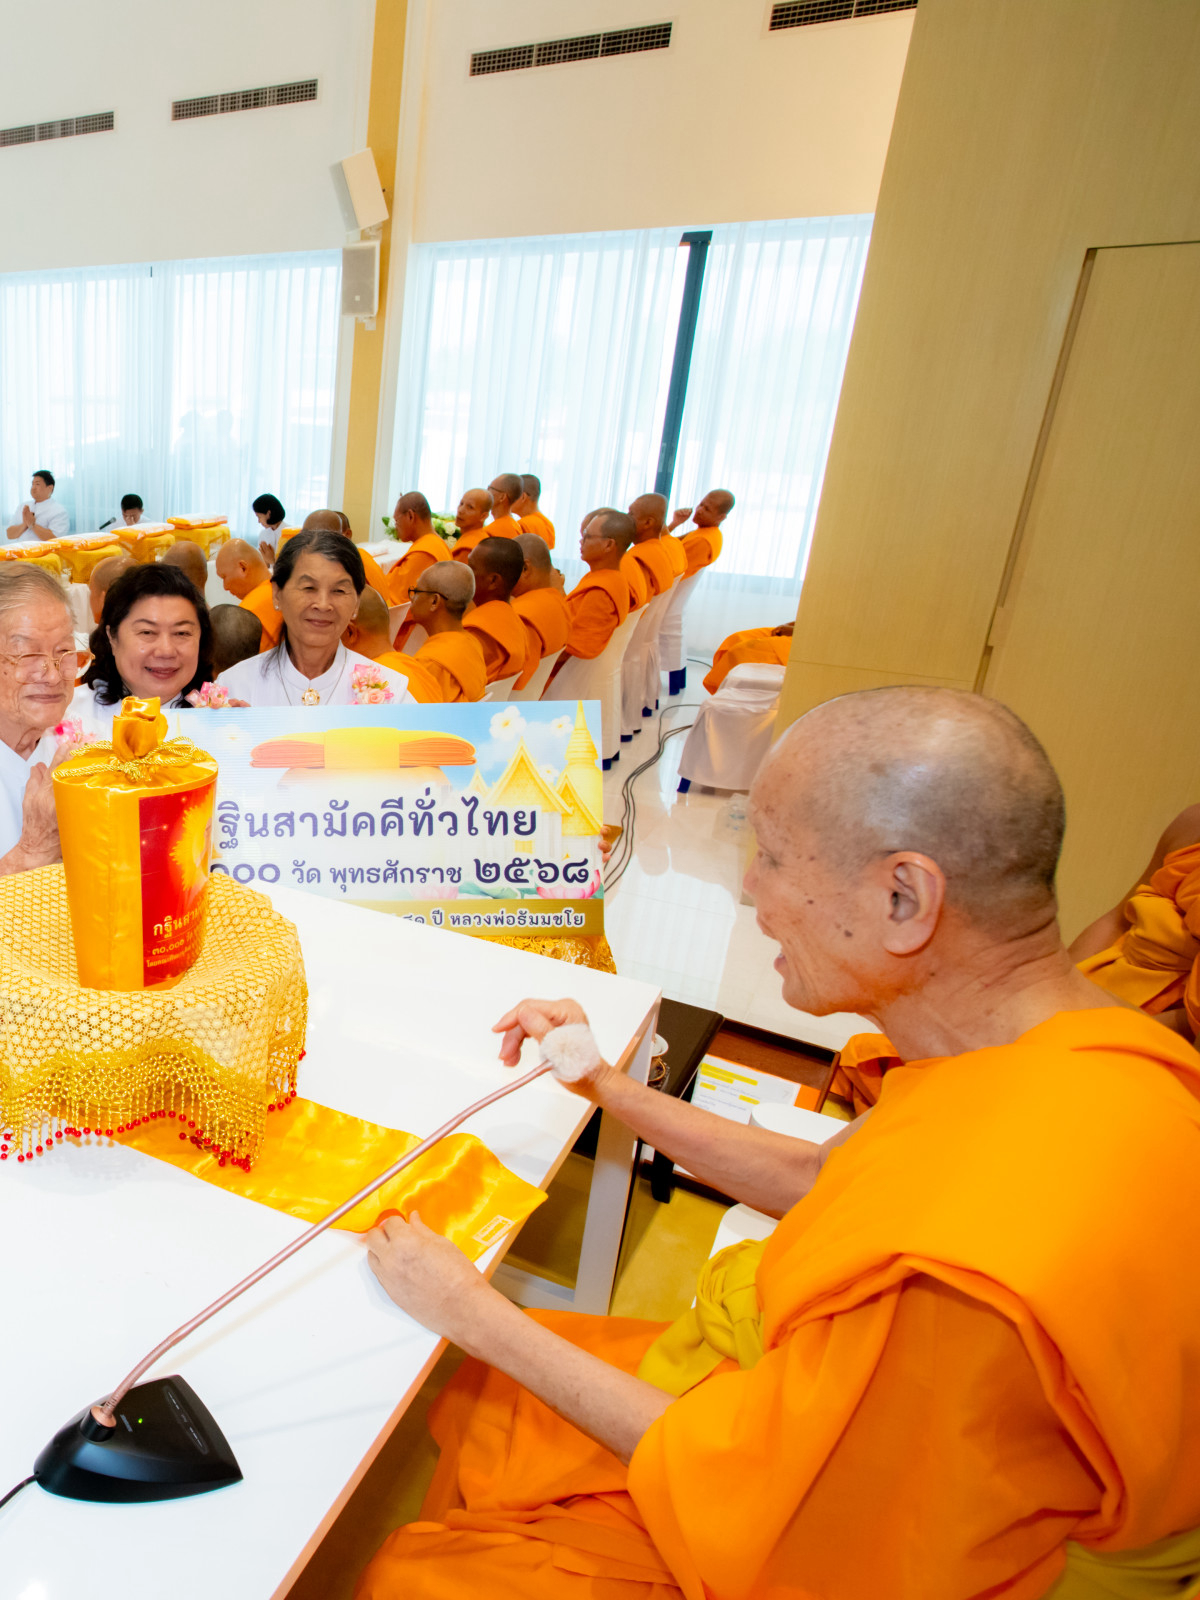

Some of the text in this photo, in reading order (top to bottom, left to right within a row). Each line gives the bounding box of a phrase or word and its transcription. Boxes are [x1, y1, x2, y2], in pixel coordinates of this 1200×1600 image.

[217, 788, 538, 849] ฐินสามัคคีทั่วไทย
[292, 859, 321, 884] วัด
[329, 859, 462, 893] พุทธศักราช
[475, 857, 590, 885] ๒๕๖๘
[432, 909, 443, 926] ปี
[450, 909, 583, 926] หลวงพ่อธัมมชโย
